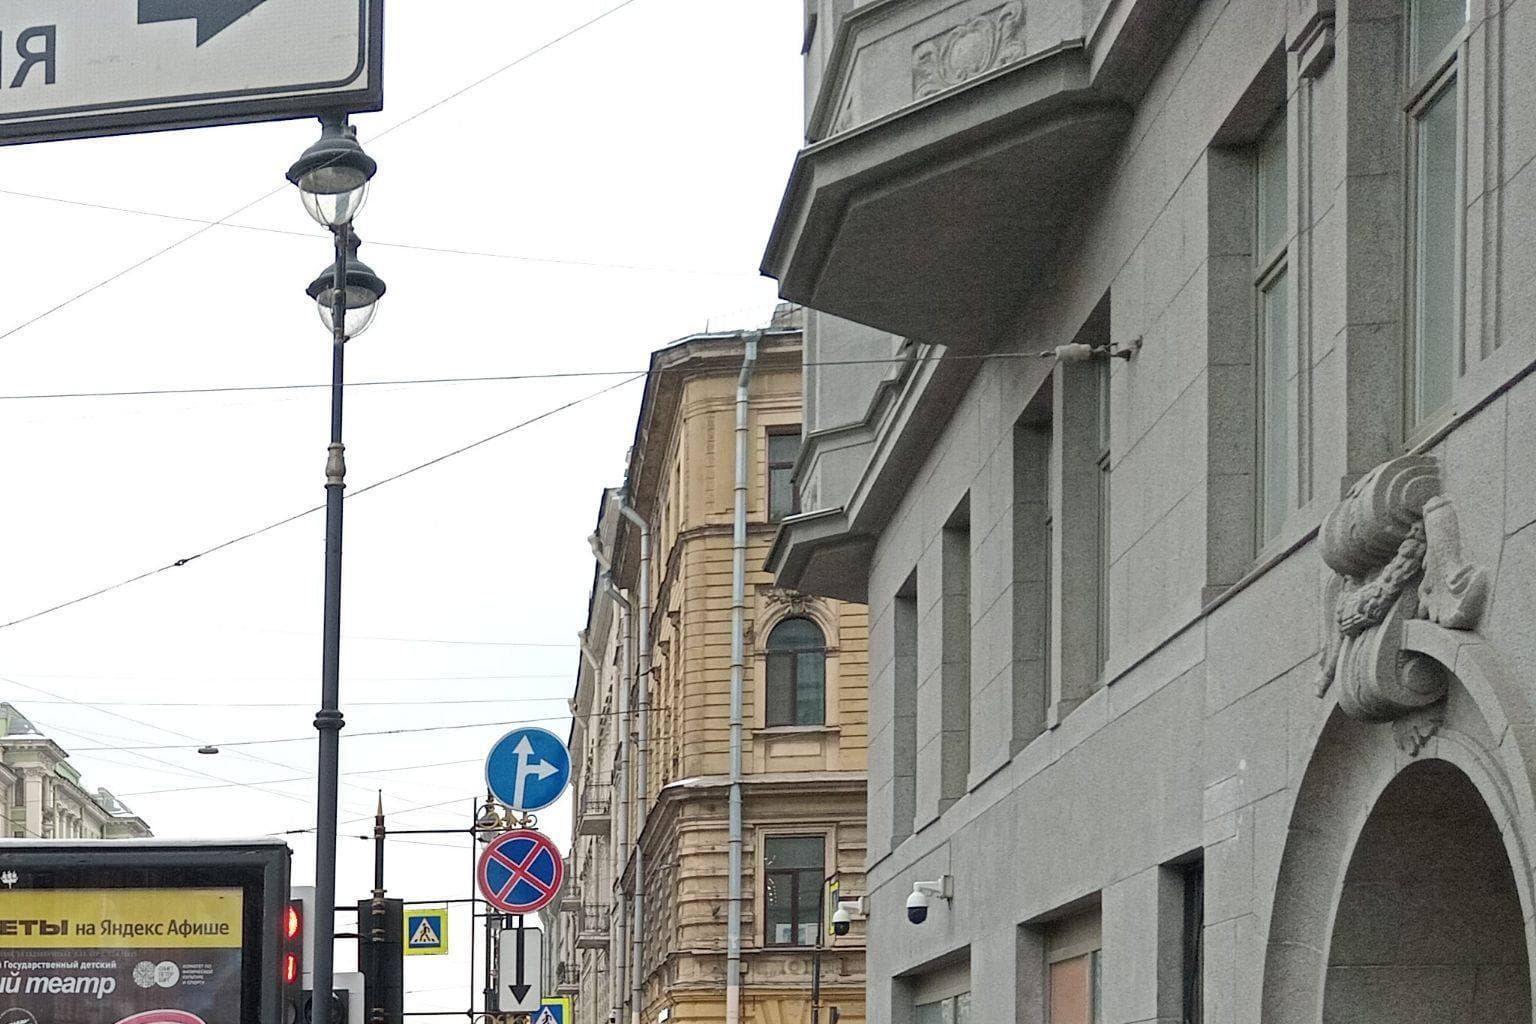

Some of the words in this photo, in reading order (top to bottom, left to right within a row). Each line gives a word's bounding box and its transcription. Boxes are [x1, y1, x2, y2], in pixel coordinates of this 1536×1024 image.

[75, 923, 96, 936] на
[100, 919, 164, 938] Яндекс
[166, 919, 230, 938] Афише
[3, 959, 79, 971] Государственный
[79, 959, 118, 970] детский
[24, 975, 116, 1000] театр
